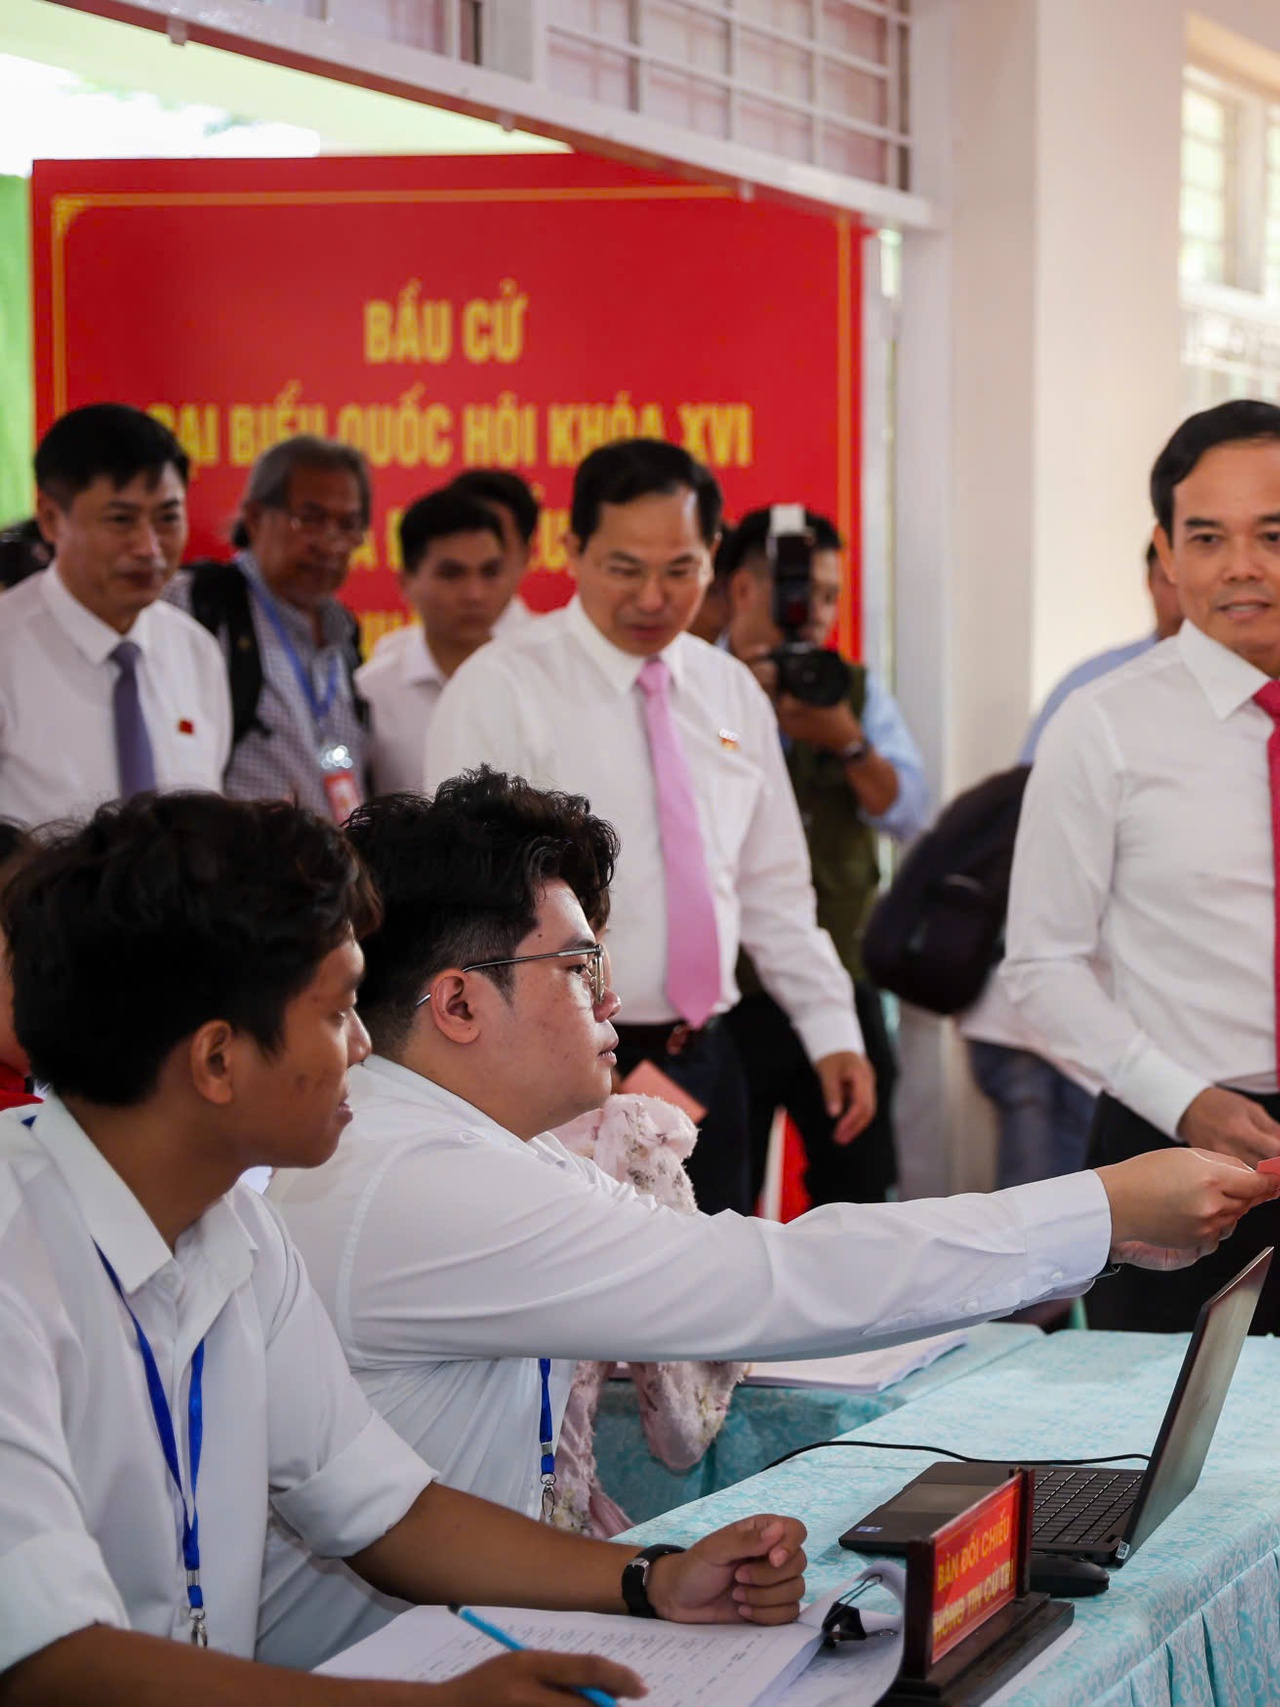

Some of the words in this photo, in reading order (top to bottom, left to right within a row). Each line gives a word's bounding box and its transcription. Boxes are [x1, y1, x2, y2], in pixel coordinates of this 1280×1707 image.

[363, 277, 453, 364] BẦU
[463, 277, 530, 364] CỬ
[148, 402, 218, 478] ẠI
[679, 402, 752, 467] XVI
